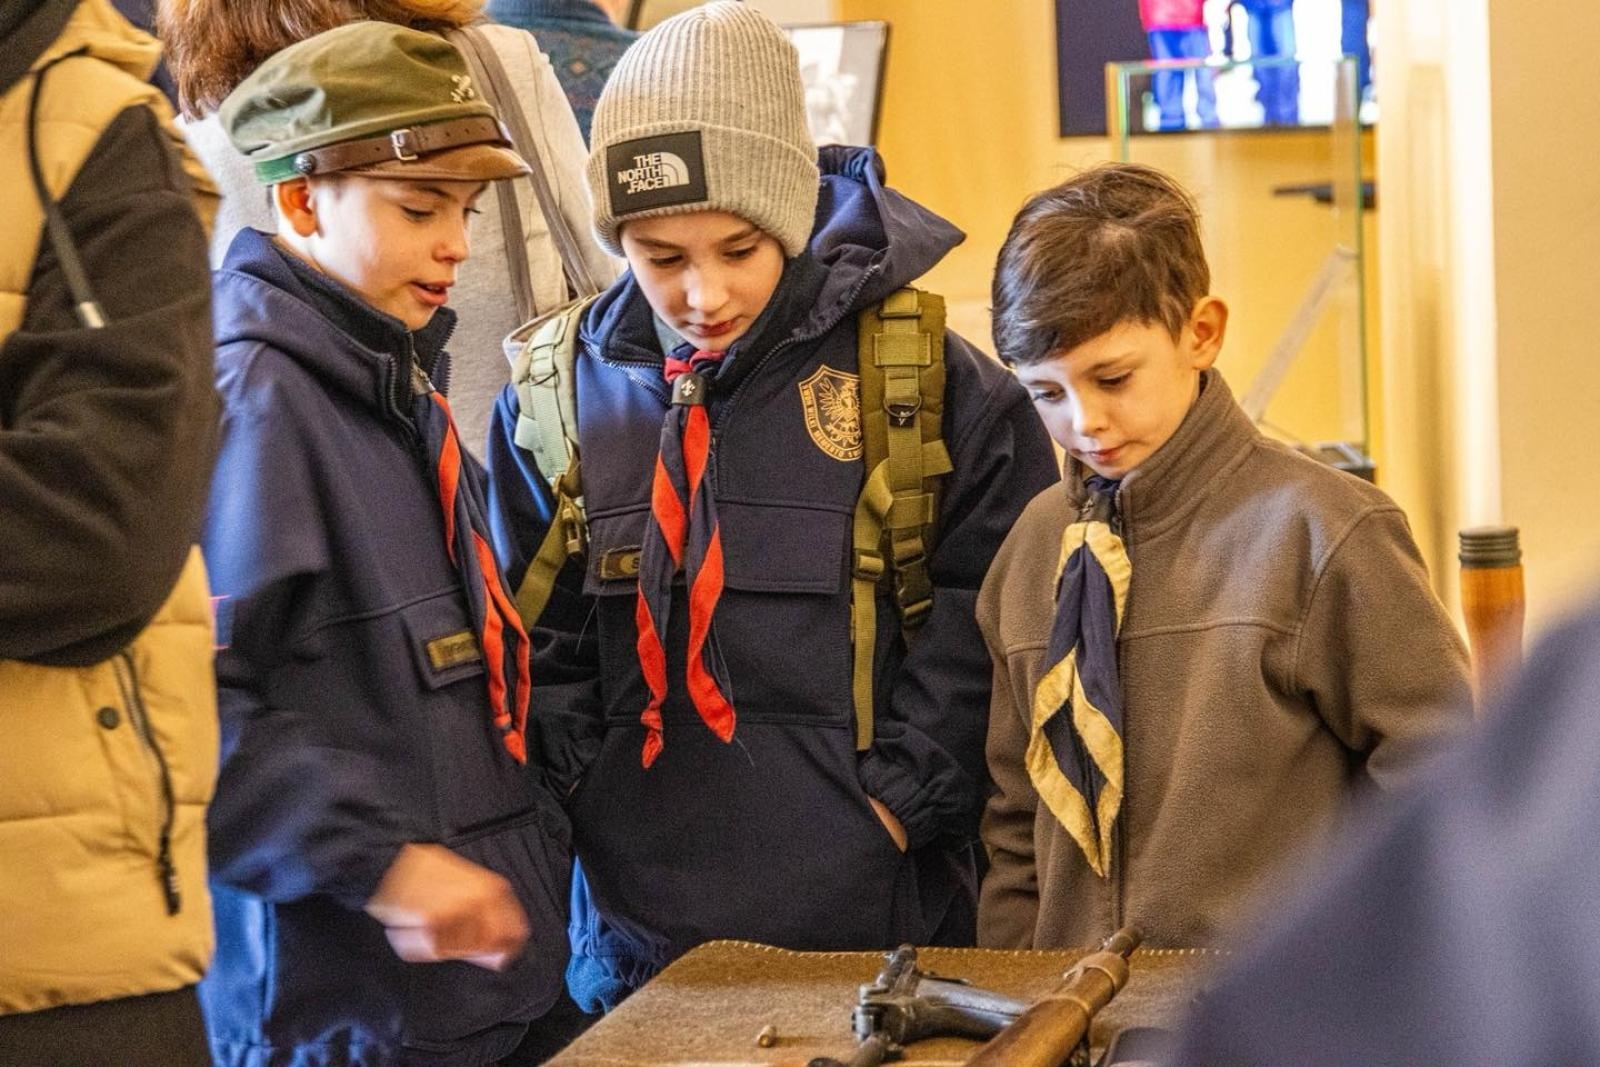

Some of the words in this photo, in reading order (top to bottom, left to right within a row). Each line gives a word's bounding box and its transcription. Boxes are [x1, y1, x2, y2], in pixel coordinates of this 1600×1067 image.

[633, 153, 661, 168] THE
[617, 165, 662, 184] NORTH
[629, 177, 664, 193] FACE
